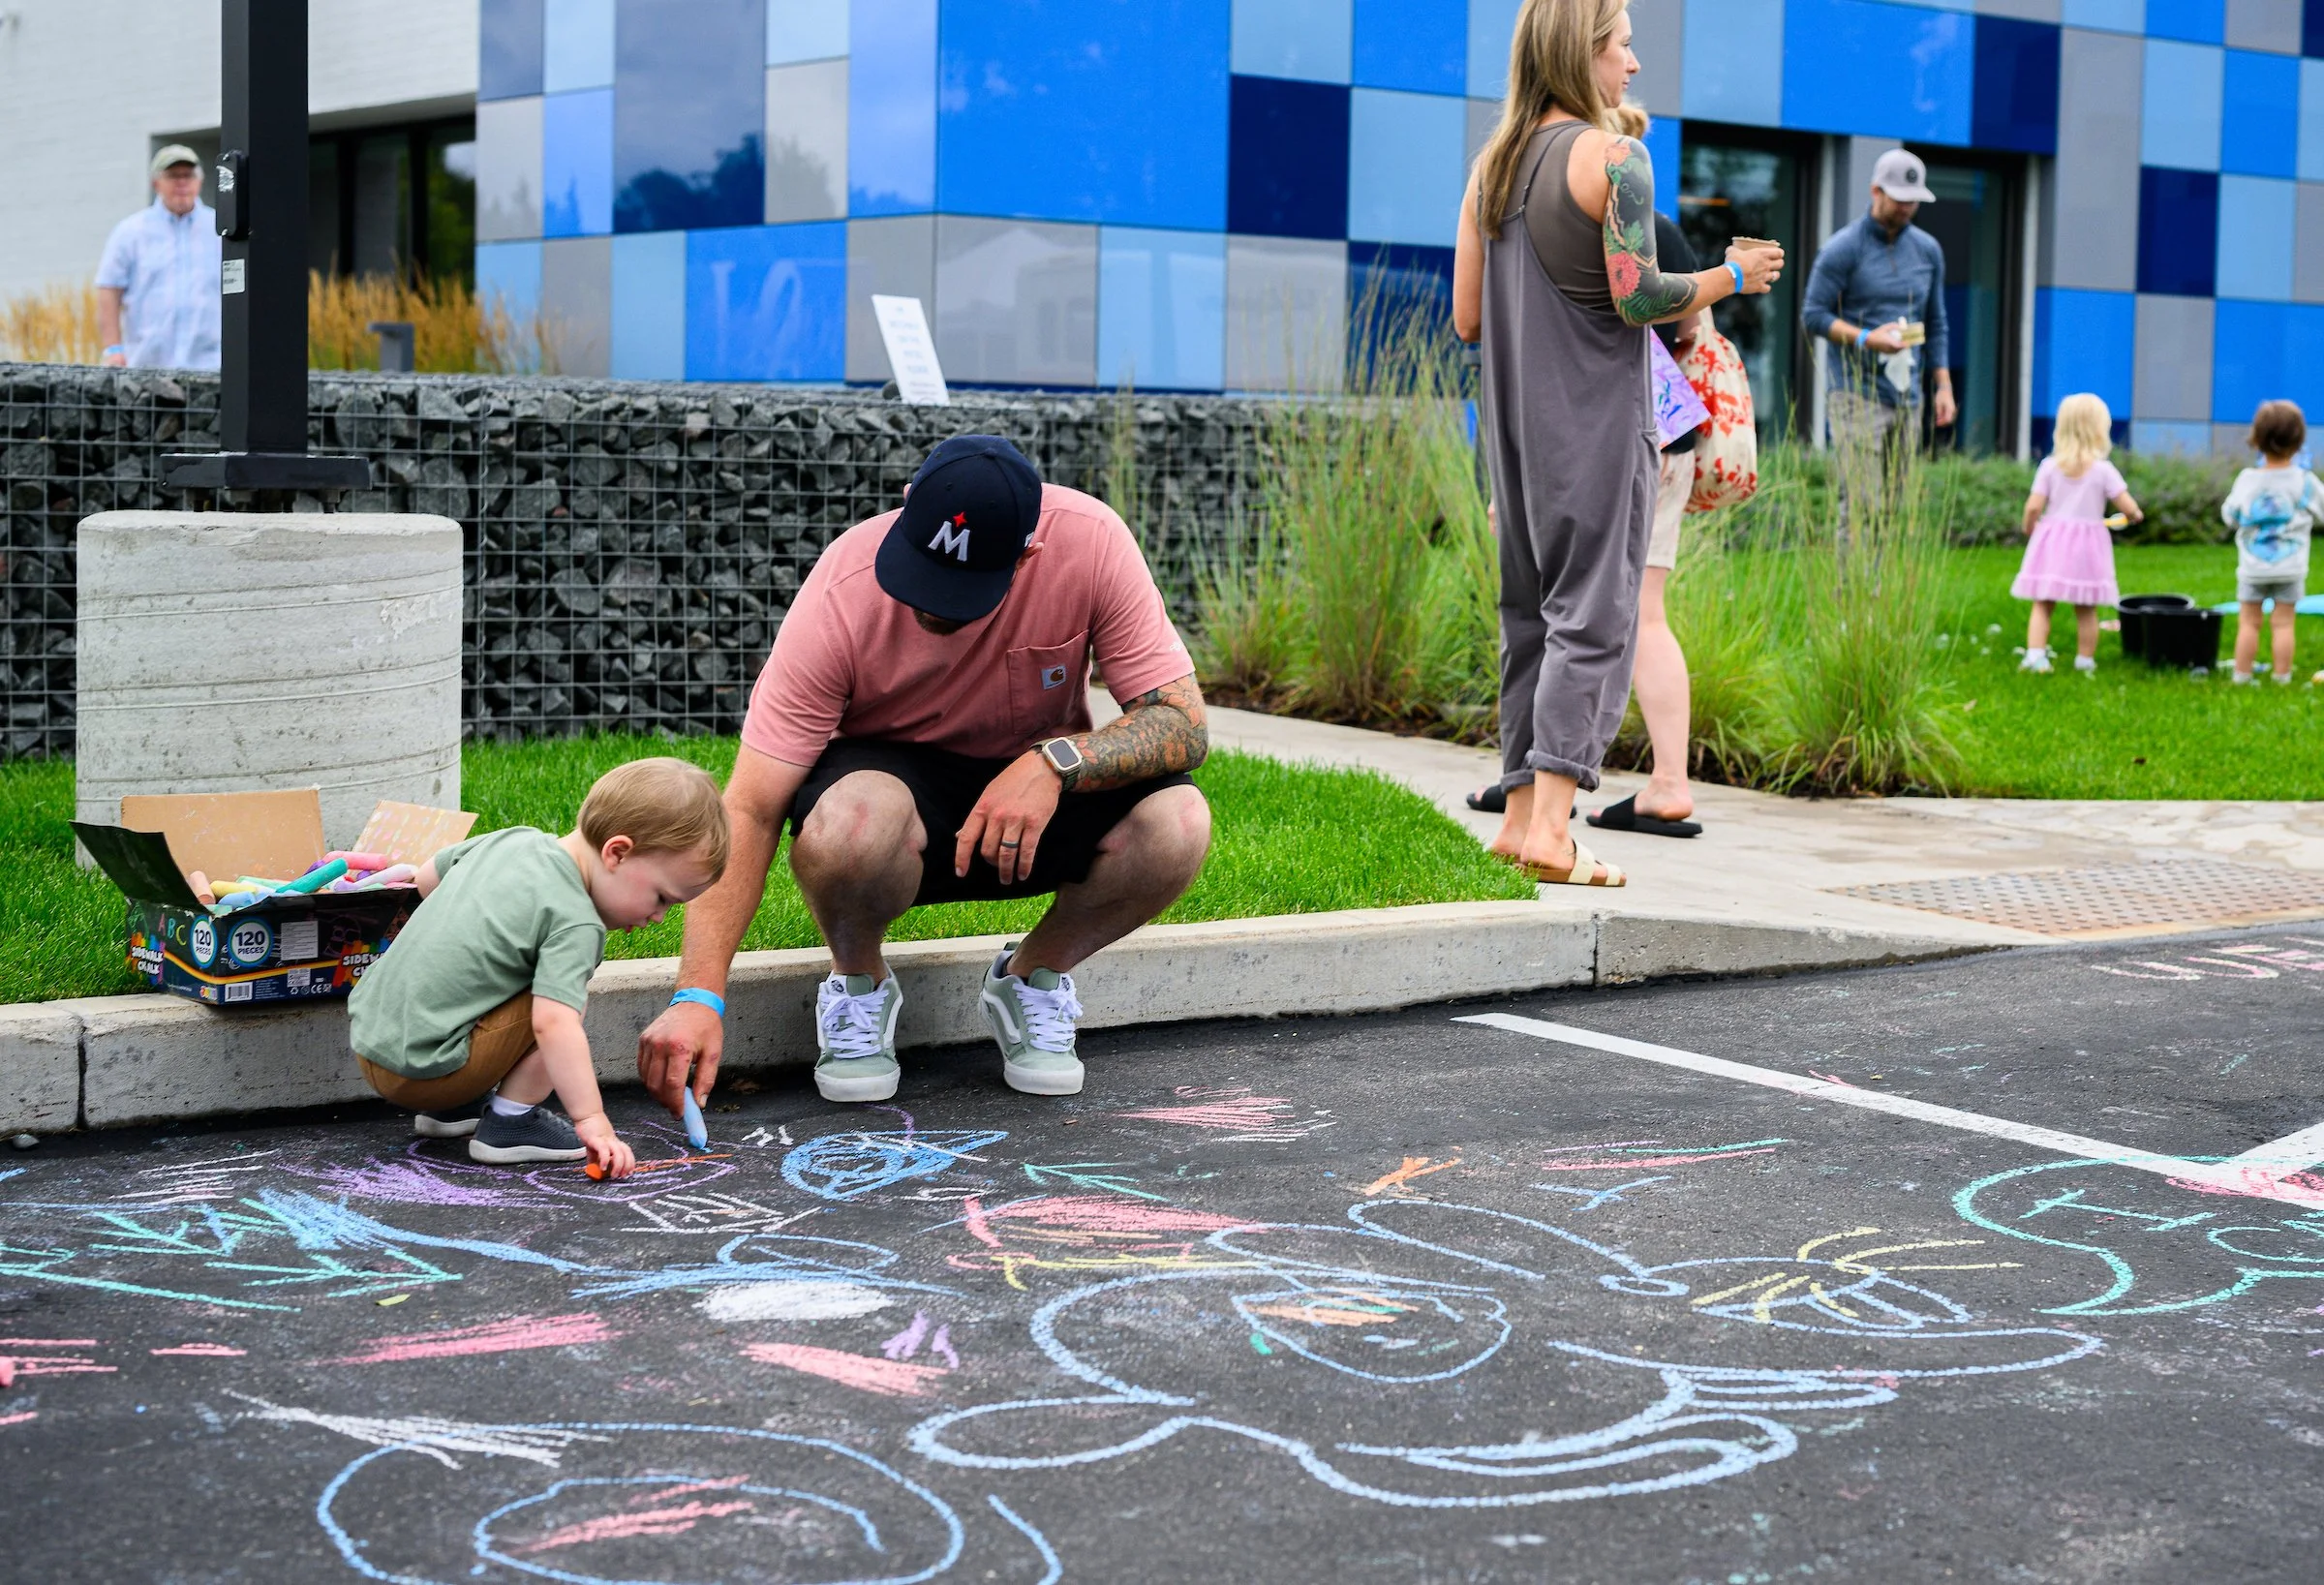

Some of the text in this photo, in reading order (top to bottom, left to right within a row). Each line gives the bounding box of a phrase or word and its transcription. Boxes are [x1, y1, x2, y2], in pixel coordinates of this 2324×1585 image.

[928, 520, 970, 562] M
[195, 930, 212, 947] 120
[235, 930, 265, 946] 120
[131, 946, 164, 963] SIDEWALK
[342, 953, 385, 966] SIDEW
[137, 960, 160, 975] CHALK
